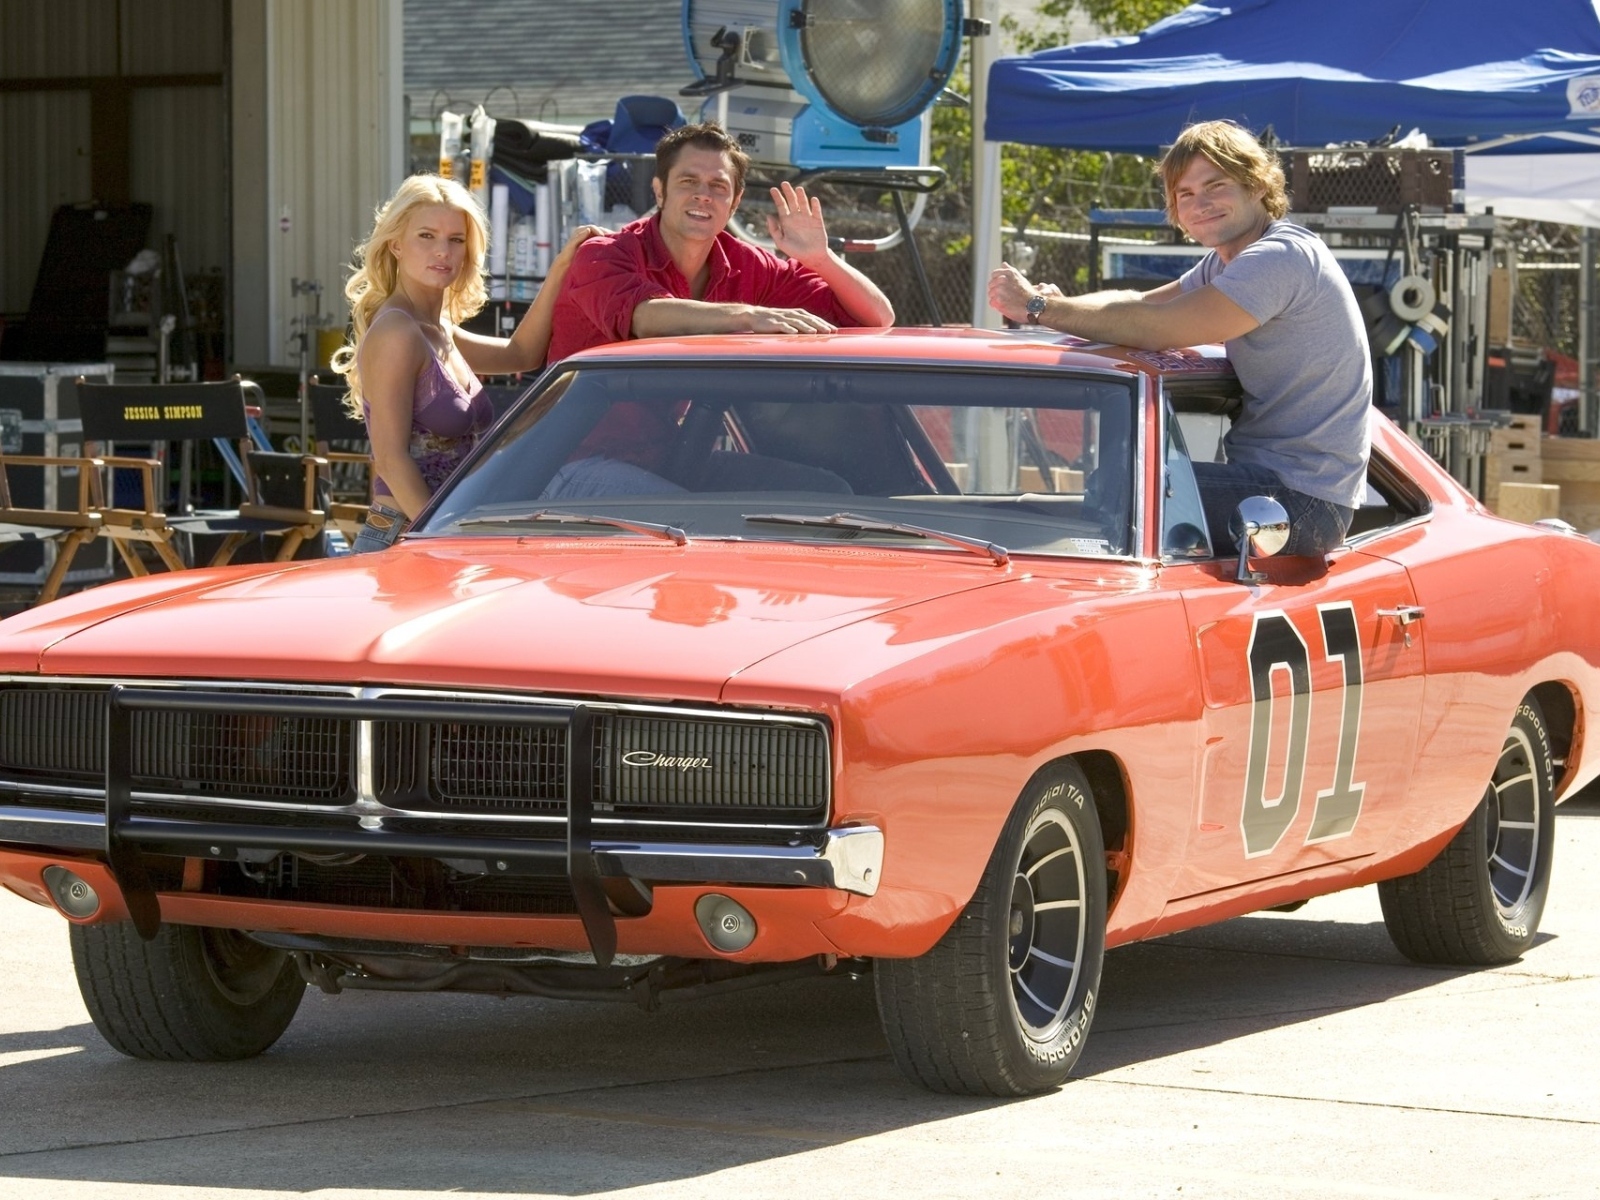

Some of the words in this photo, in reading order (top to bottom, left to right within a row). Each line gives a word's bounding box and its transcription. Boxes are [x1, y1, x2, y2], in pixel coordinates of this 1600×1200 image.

[124, 406, 160, 420] JESSICA
[164, 405, 203, 419] SIMPSON
[622, 750, 713, 772] Charger
[1240, 600, 1366, 860] 01
[1516, 704, 1554, 792] FGoodrich
[1024, 782, 1065, 838] Radial
[1066, 784, 1085, 810] T/A
[1020, 988, 1094, 1065] BFGoodrich
